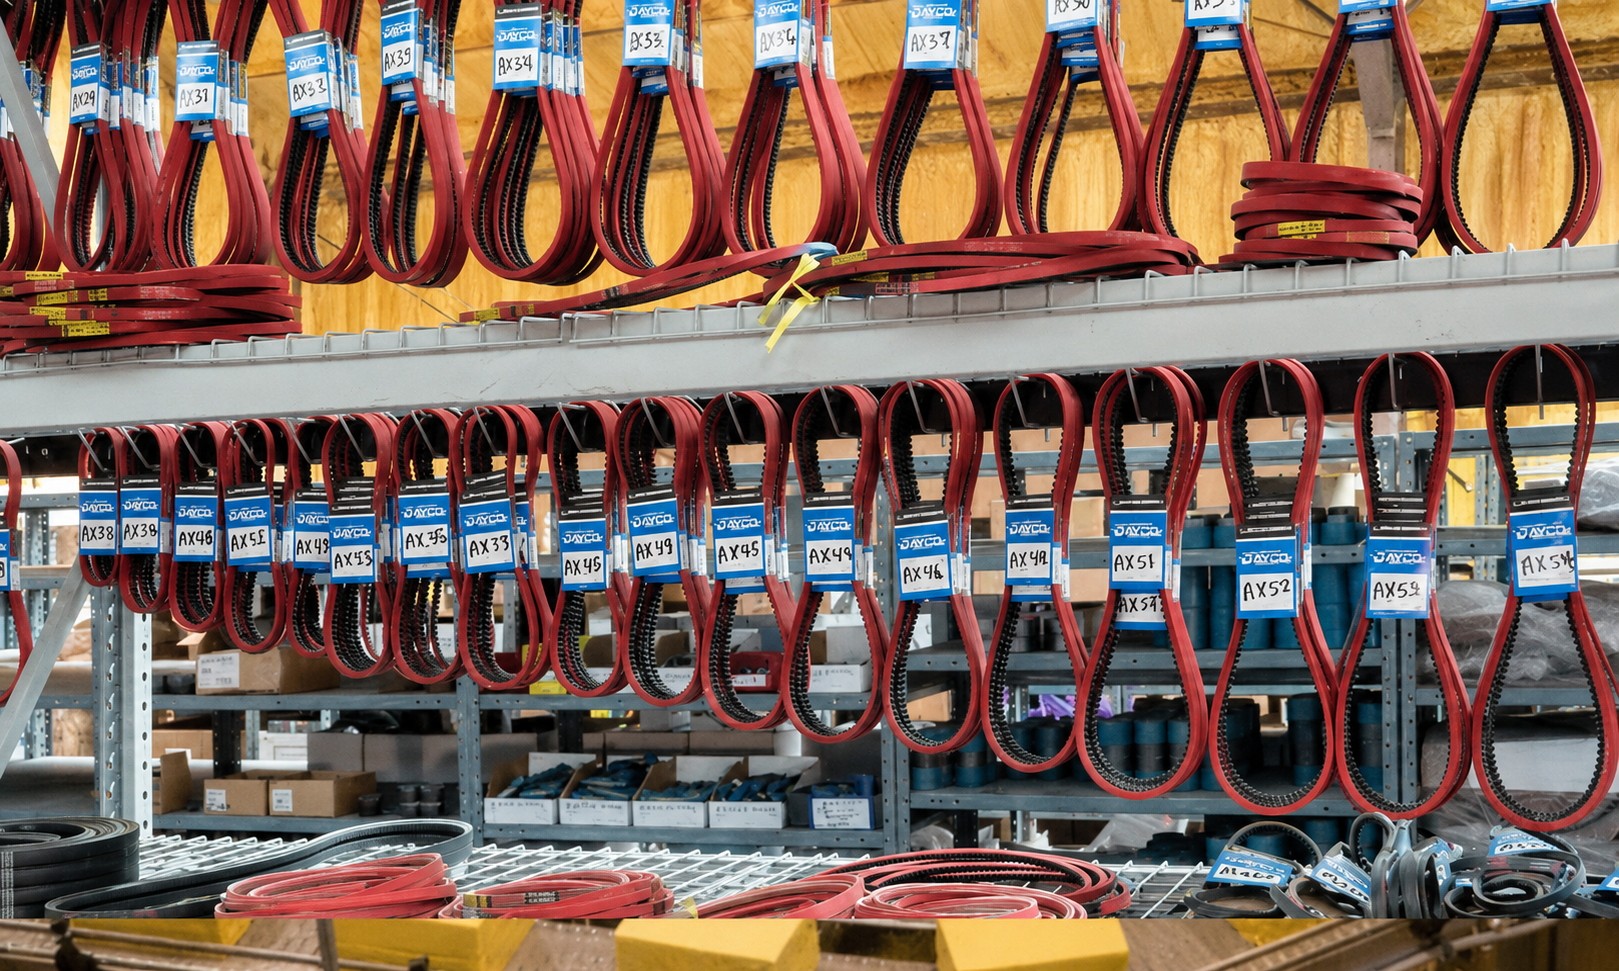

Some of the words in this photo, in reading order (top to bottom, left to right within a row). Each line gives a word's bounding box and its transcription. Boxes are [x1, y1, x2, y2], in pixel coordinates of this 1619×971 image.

[626, 4, 671, 17] DAYCO
[755, 3, 798, 17] DAYCO
[909, 5, 956, 17] DAYCO
[497, 30, 538, 42] DAYCO
[72, 91, 96, 112] AX29
[80, 503, 114, 513] DAYCO
[176, 508, 214, 518] DAYCO
[401, 507, 447, 518] DAYCO
[227, 509, 267, 521] DAYCO
[464, 513, 509, 527] DAYCO
[630, 514, 675, 528] DAYCO
[714, 518, 761, 530] DAYCO
[805, 520, 852, 532] DAYCO
[1007, 523, 1050, 535] DAYCO
[81, 525, 114, 542] AX38
[330, 528, 371, 539] DAYCO
[1111, 525, 1163, 537] DAYCO
[1512, 526, 1572, 540] DAYCO
[562, 533, 603, 543] DAYCO
[898, 537, 946, 550] DAYCO
[1239, 552, 1292, 565] DAYCO
[1370, 551, 1426, 564] DAYCO
[1243, 578, 1291, 602] AX52
